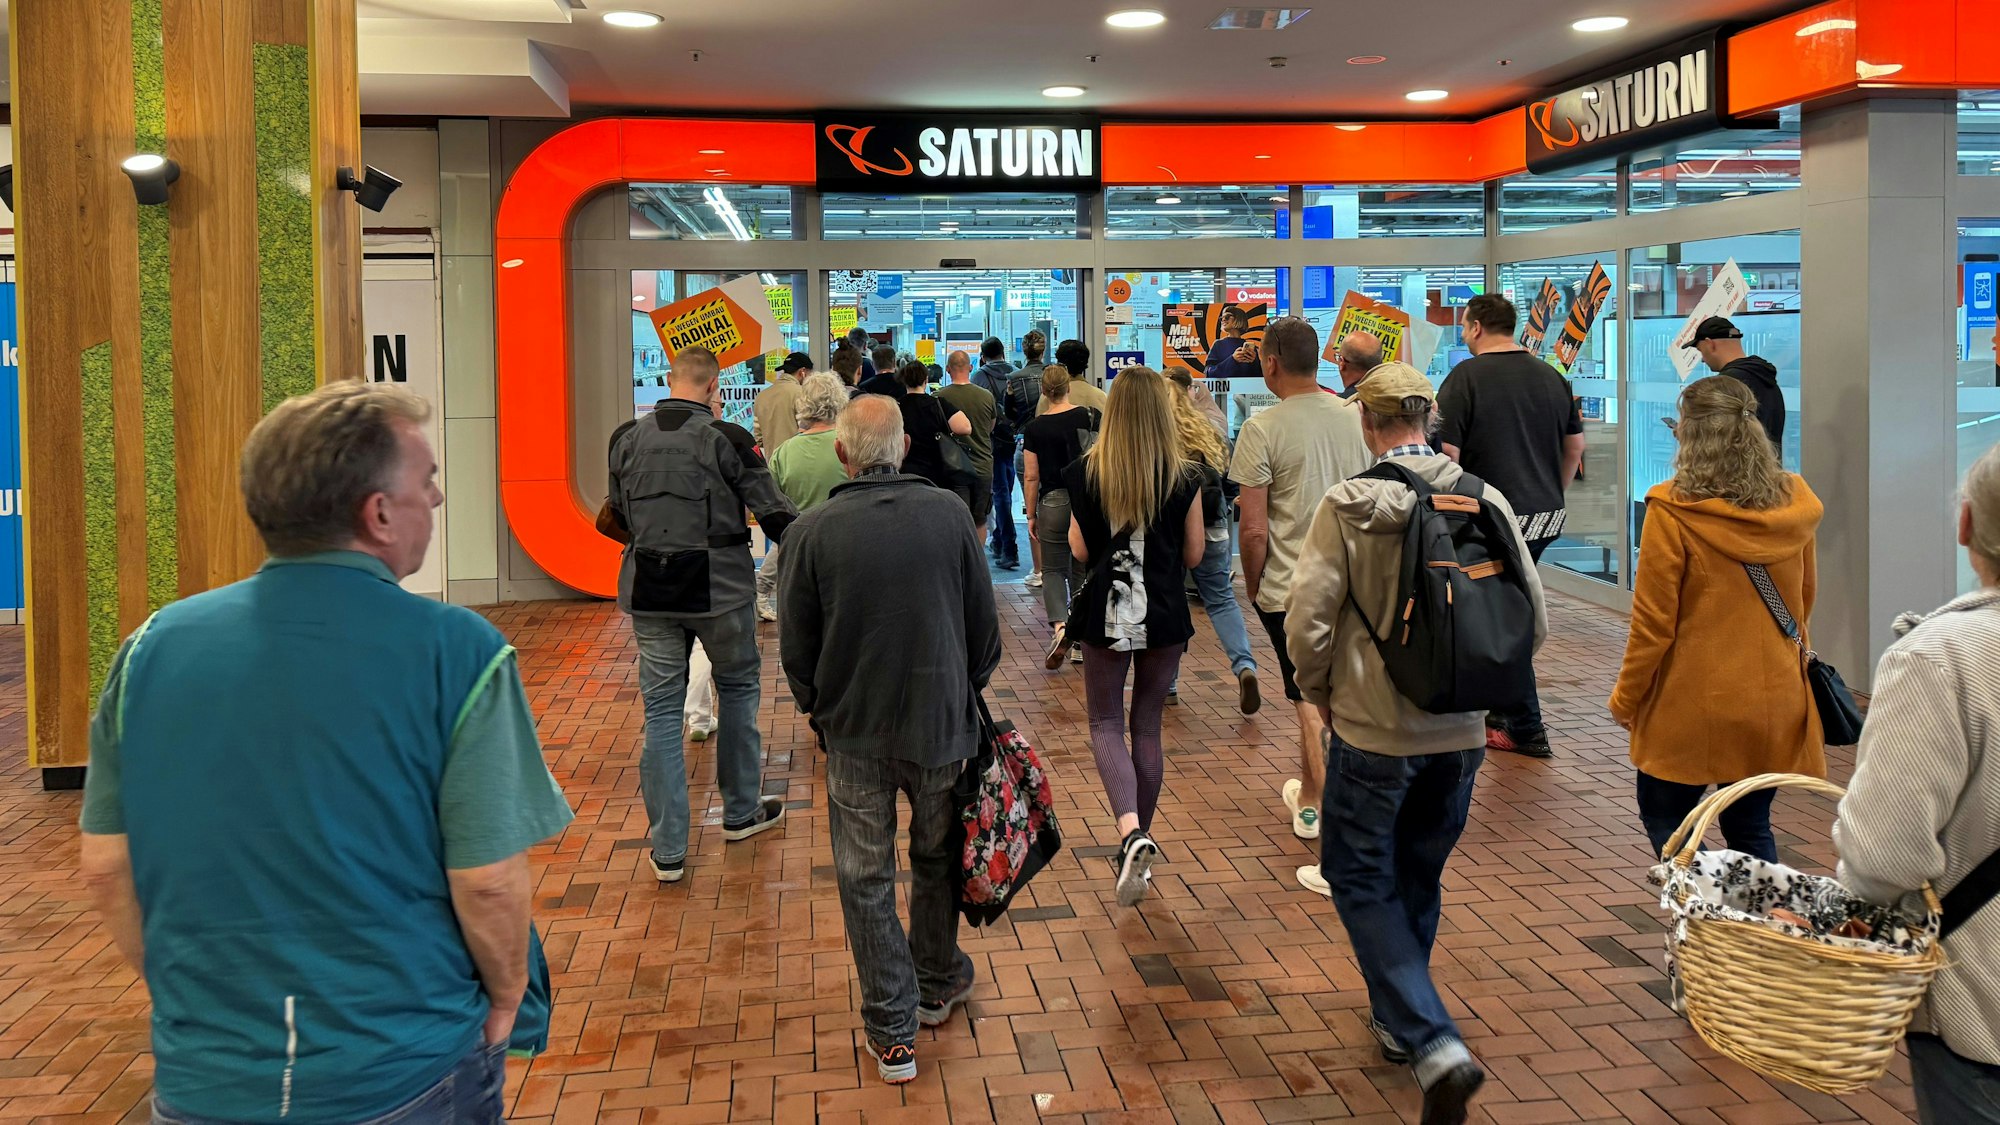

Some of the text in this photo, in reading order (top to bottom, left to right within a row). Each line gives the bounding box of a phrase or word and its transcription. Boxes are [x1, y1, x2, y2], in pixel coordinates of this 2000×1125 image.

[1580, 49, 1707, 143] SATURN
[918, 127, 1092, 177] SATURN
[1113, 287, 1125, 295] 56
[768, 299, 792, 308] IKAL
[675, 306, 725, 332] WEGEN UMBAU
[1169, 324, 1192, 335] Mai
[1355, 315, 1400, 336] WEGEN UMBAU
[670, 315, 732, 351] RADIKAL
[700, 329, 737, 350] ZIERT!
[1166, 336, 1200, 349] Lights
[1341, 320, 1396, 350] RAAL
[364, 334, 407, 382] N
[719, 388, 760, 400] ATURN
[1203, 380, 1230, 393] URN
